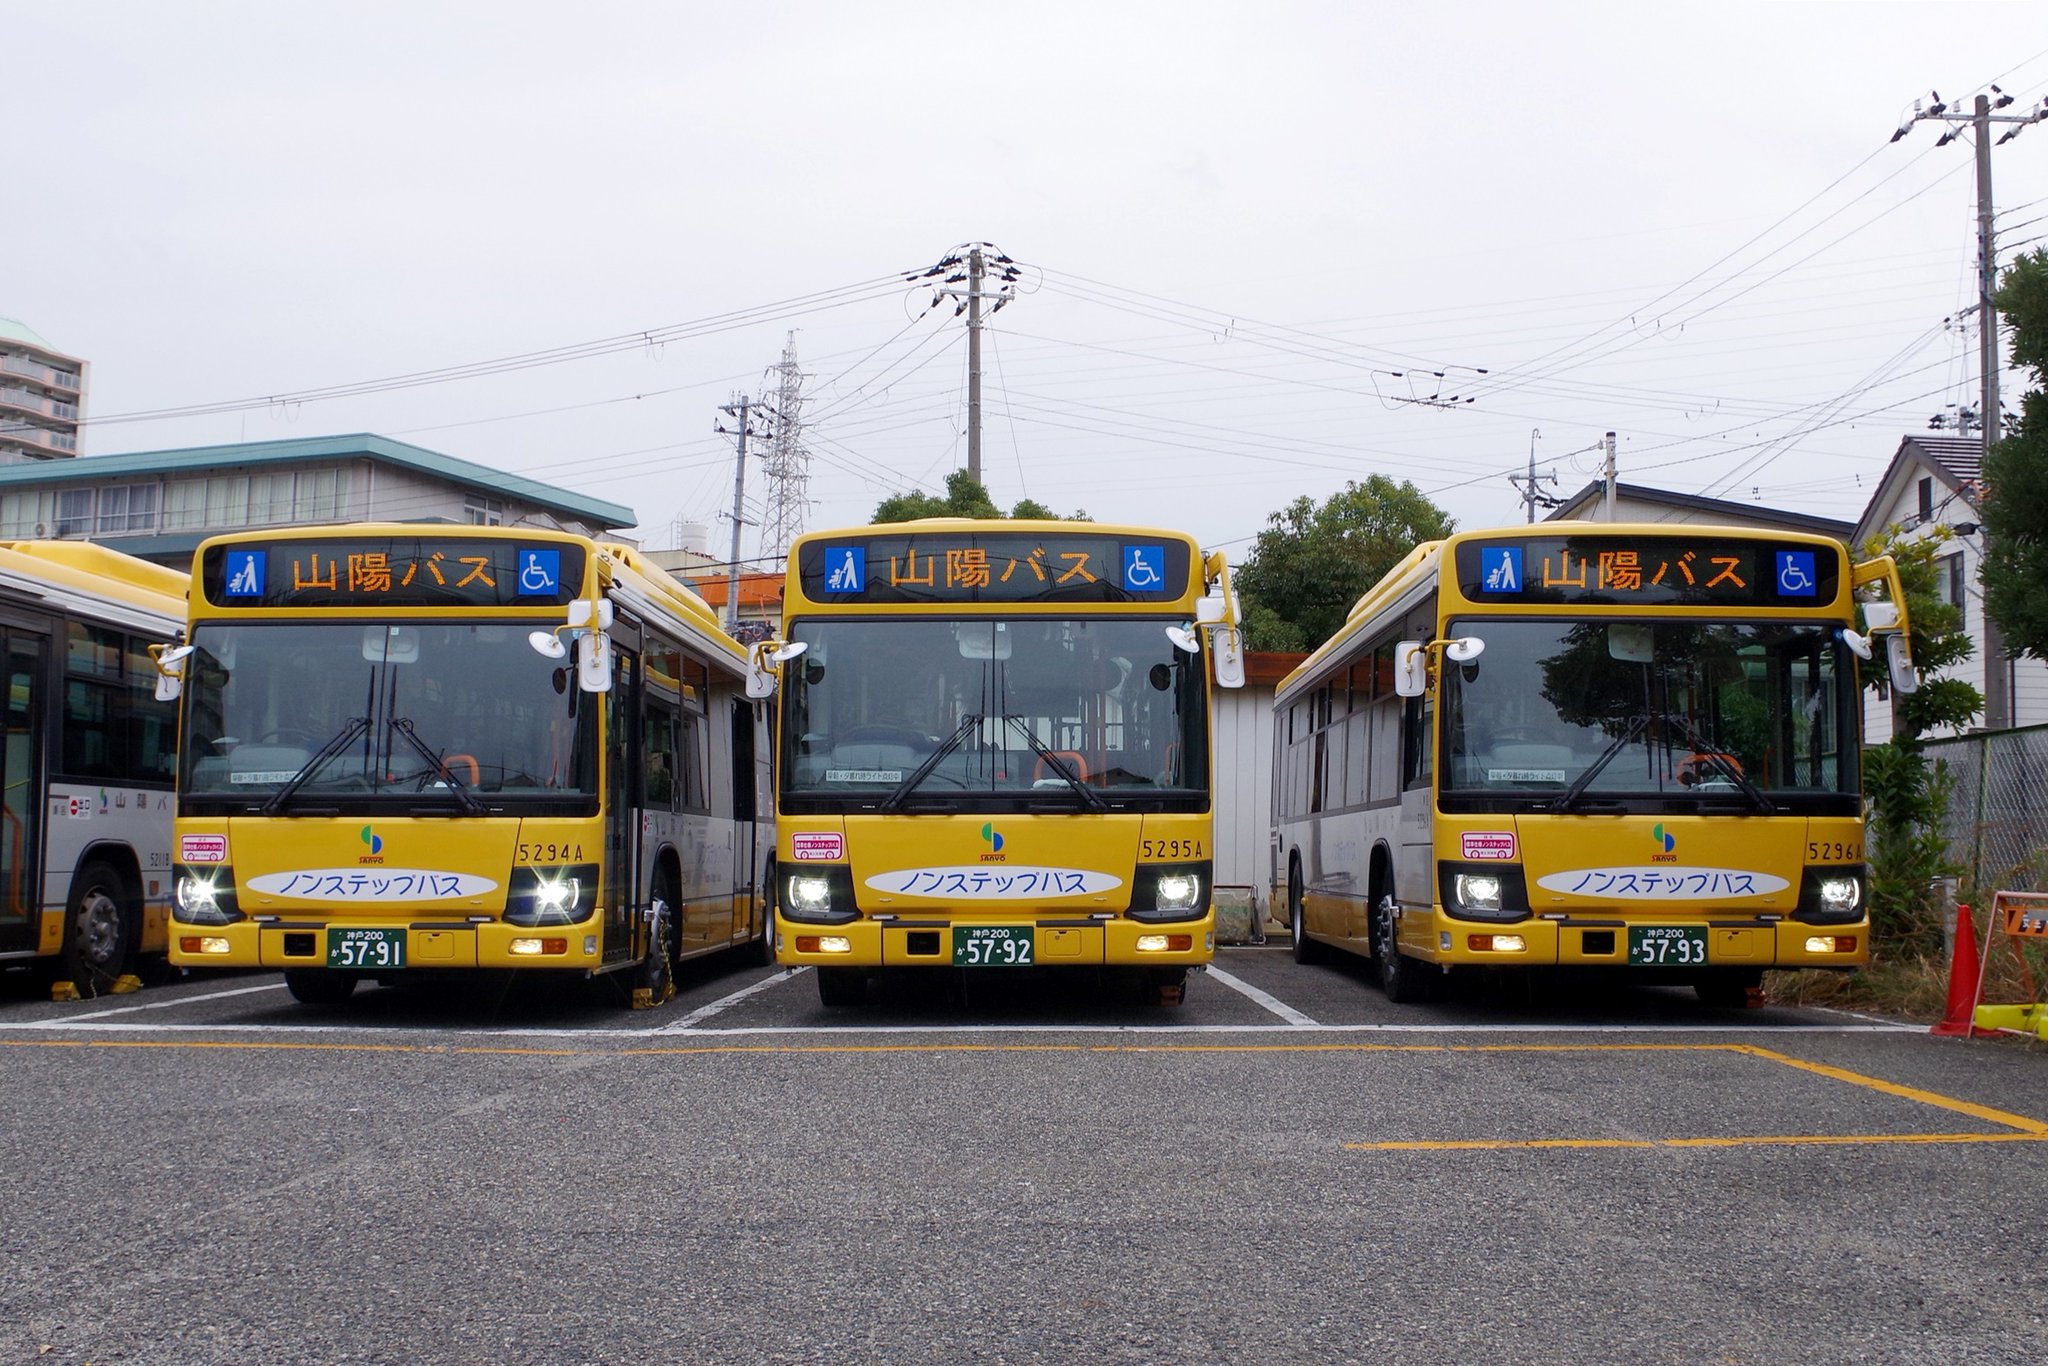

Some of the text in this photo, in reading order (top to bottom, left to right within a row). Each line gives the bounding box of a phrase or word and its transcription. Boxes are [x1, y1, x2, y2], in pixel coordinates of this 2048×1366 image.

[293, 551, 496, 592] 山陽バス
[890, 547, 1098, 588] 山陽バス
[1543, 550, 1747, 590] 山陽バス
[519, 844, 583, 861] 5294A
[980, 854, 1006, 862] SANYO
[1143, 840, 1202, 858] 5295A
[1809, 843, 1861, 860] 5296A
[359, 856, 384, 864] SANYO
[280, 874, 462, 895] ノンステップバス
[900, 872, 1087, 893] ノンステップバス
[1571, 873, 1756, 895] ノンステップバス
[341, 941, 400, 965] 57-91
[967, 939, 1031, 963] 57-92
[1642, 939, 1705, 963] 57-93
